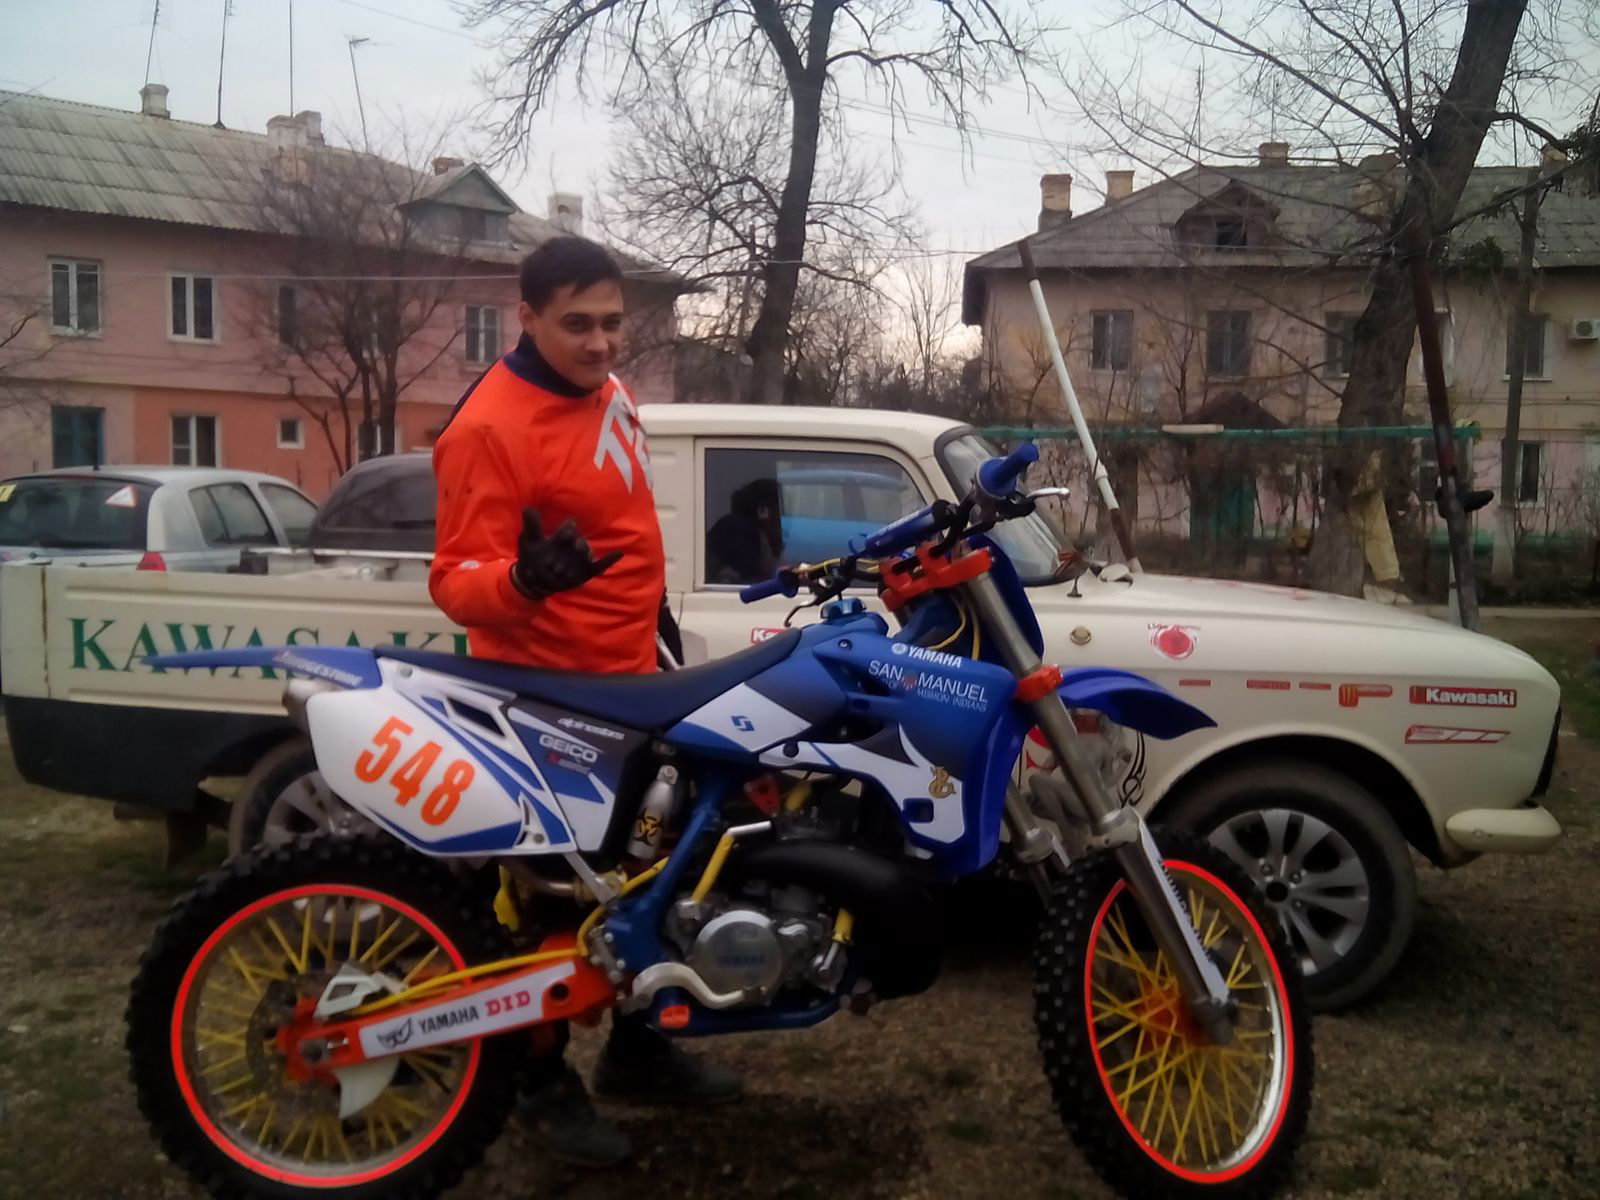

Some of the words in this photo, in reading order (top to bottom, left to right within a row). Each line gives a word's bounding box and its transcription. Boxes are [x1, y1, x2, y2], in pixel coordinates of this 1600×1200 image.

[65, 617, 468, 681] KAWA
[907, 645, 962, 669] YAMAHA
[868, 659, 903, 681] SAN
[918, 672, 988, 704] MANUEL
[1426, 688, 1515, 706] Kawasaki
[354, 715, 475, 826] 548
[539, 734, 598, 763] GEICO
[418, 1005, 479, 1036] YAMAHA
[485, 991, 531, 1017] DID
